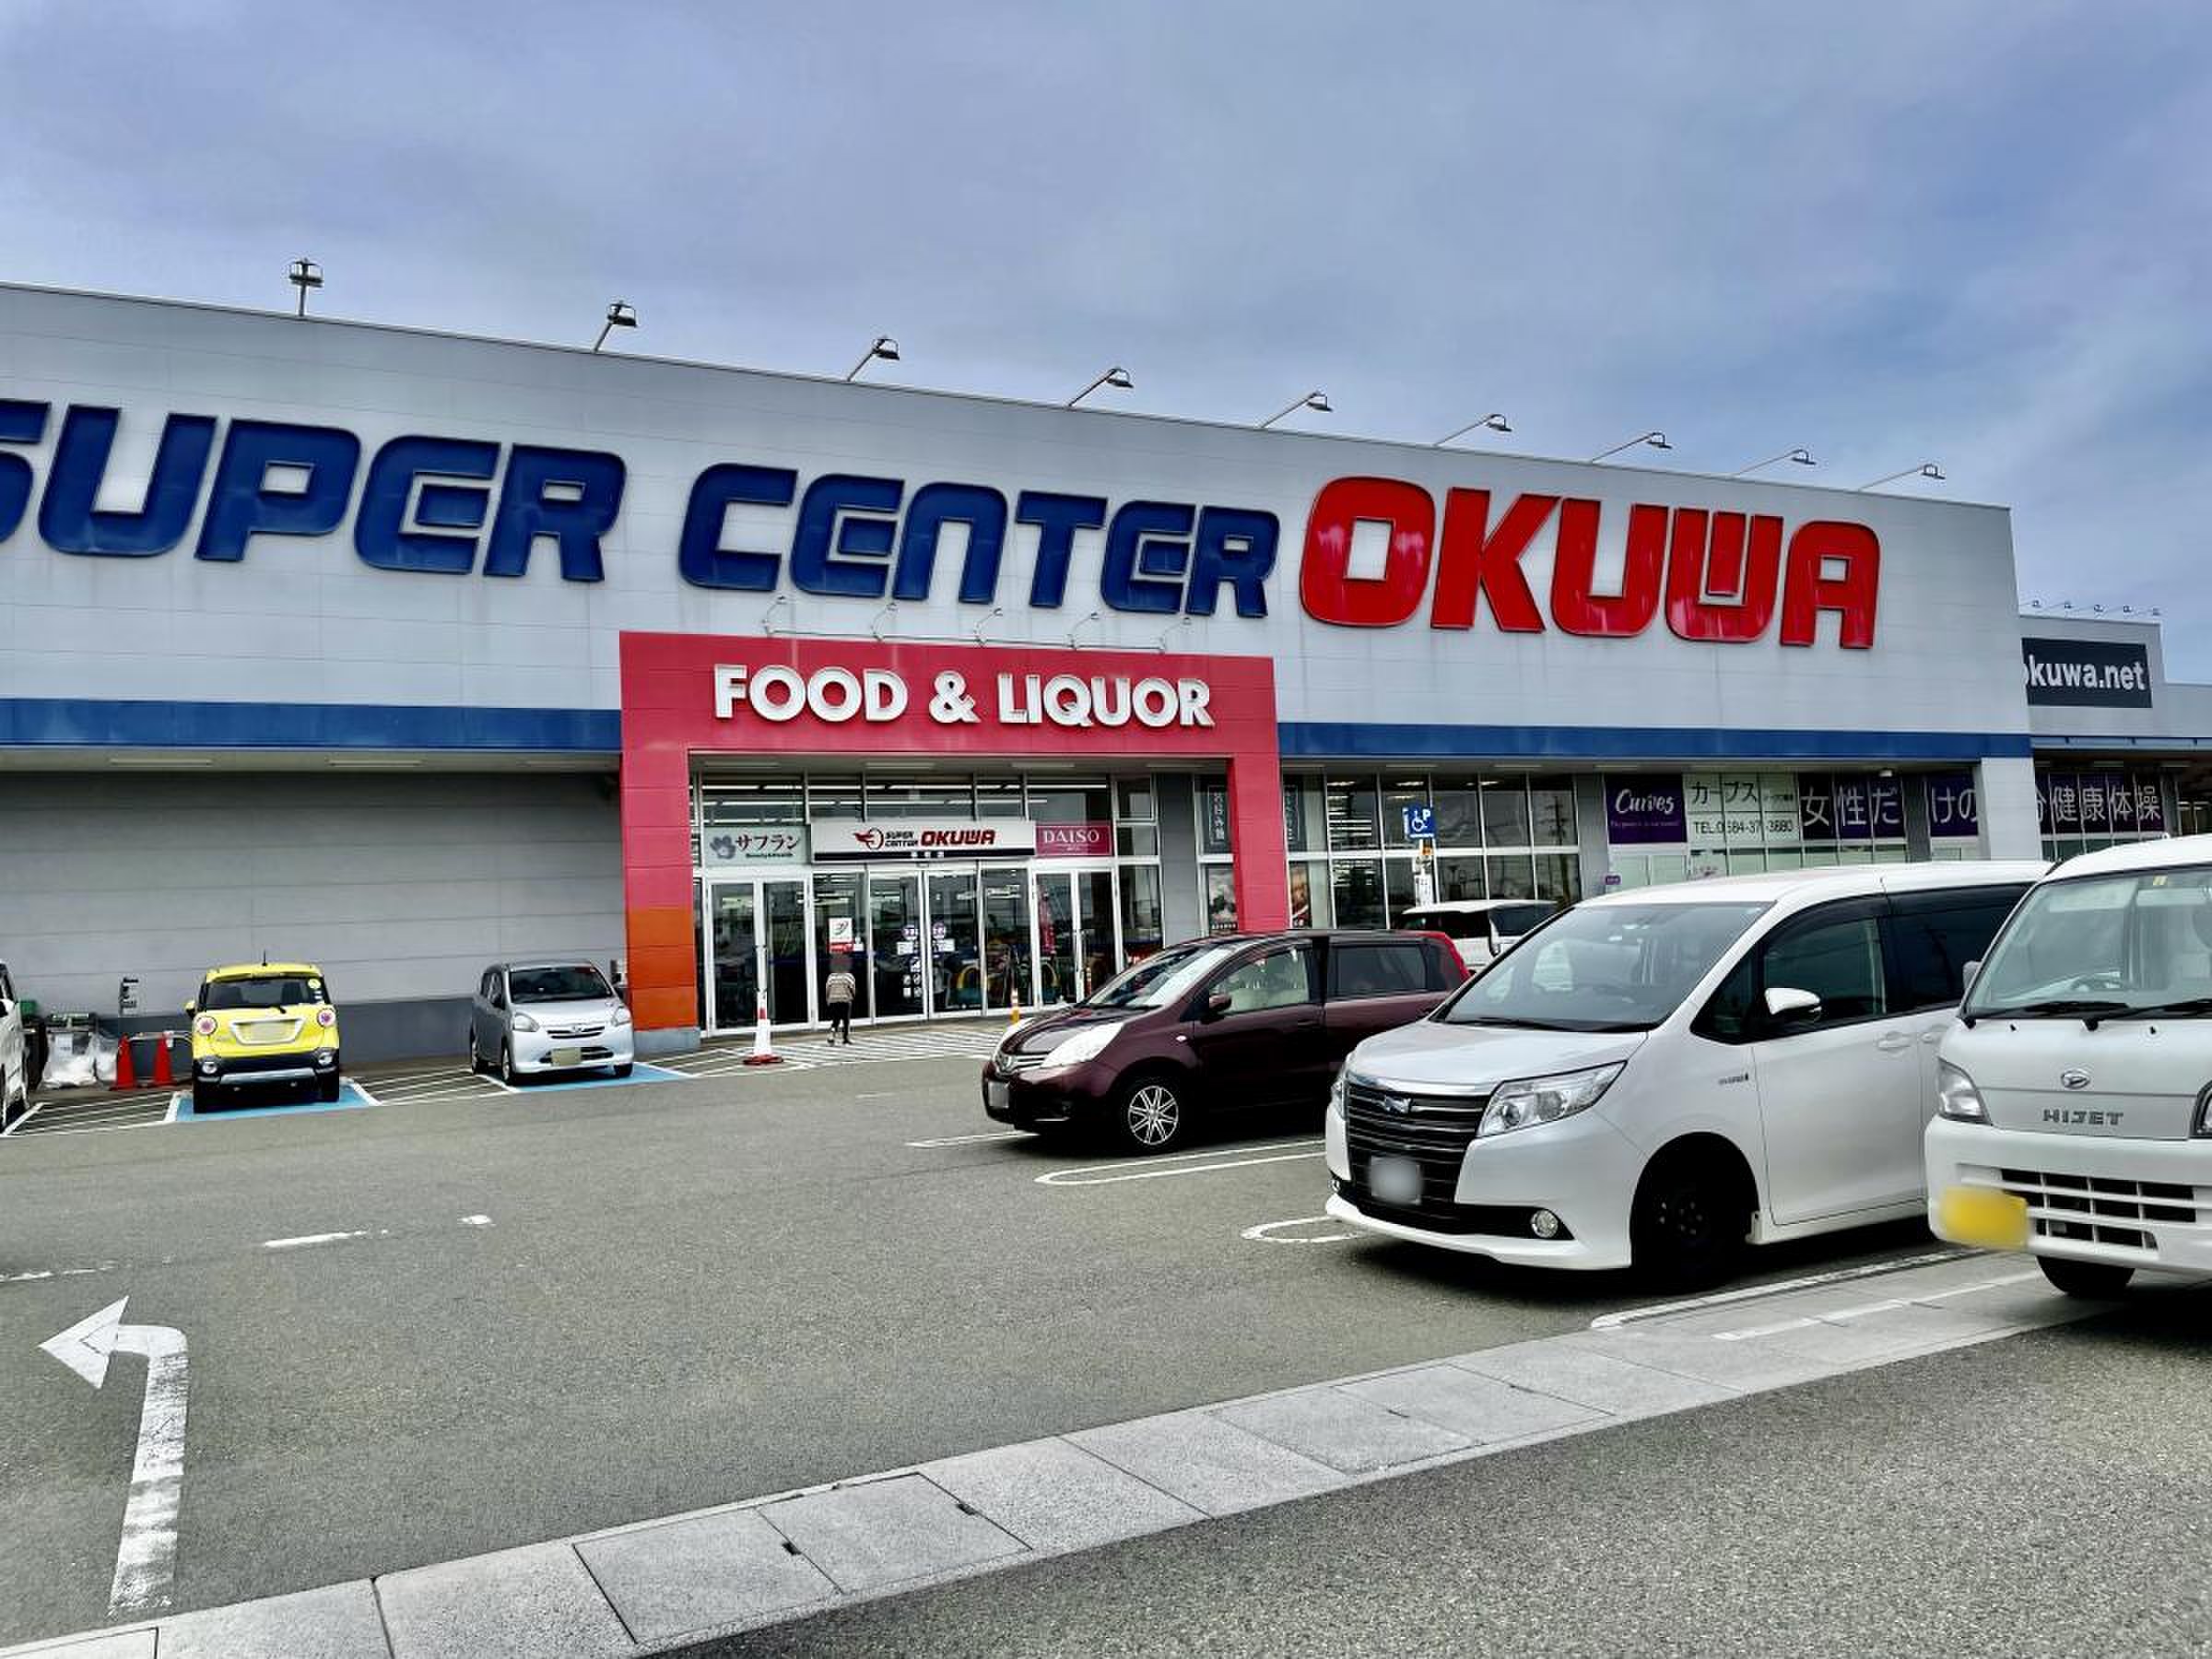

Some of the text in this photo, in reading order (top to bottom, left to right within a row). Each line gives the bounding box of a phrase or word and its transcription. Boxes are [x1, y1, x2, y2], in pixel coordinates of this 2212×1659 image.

[678, 463, 1280, 618] CENTER
[1300, 476, 1881, 649] OKUWA
[713, 664, 1216, 728] FOOD & LIQUOR
[1616, 789, 1675, 815] Curves
[735, 834, 800, 852] サフラン
[921, 830, 996, 846] OKUWA
[1043, 830, 1100, 843] DAISO
[2042, 1109, 2124, 1125] HIJET
